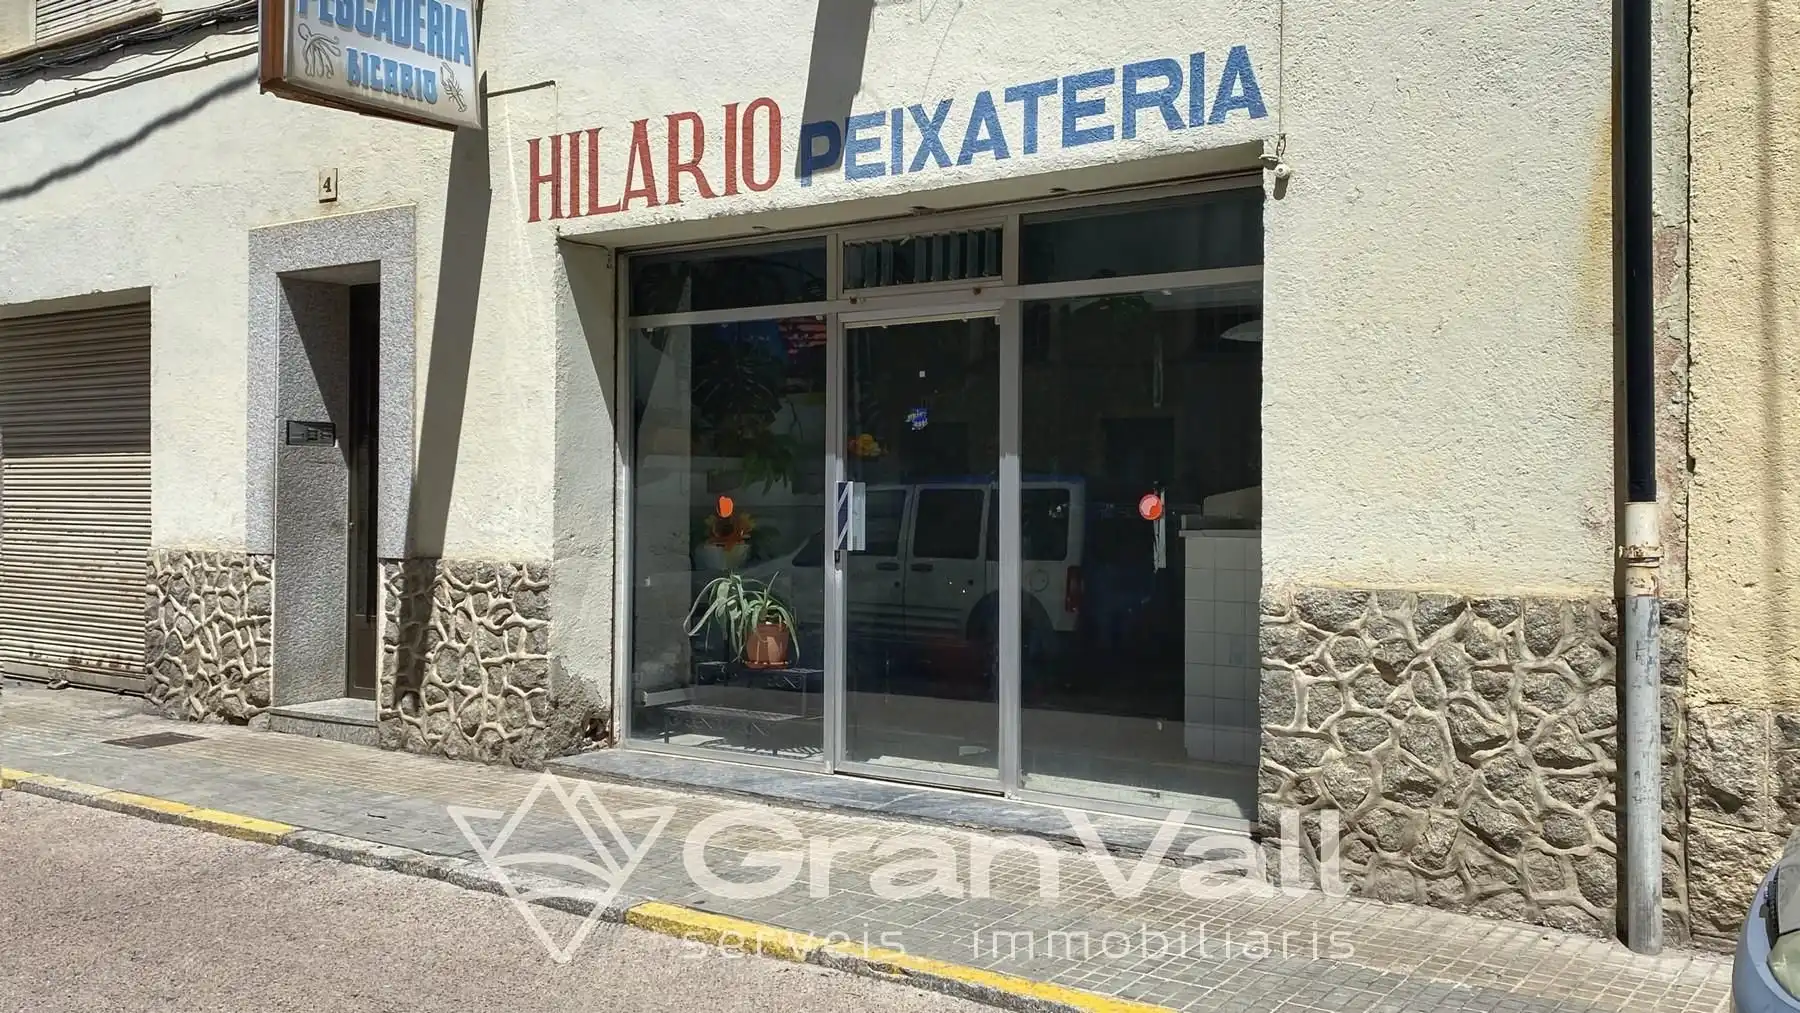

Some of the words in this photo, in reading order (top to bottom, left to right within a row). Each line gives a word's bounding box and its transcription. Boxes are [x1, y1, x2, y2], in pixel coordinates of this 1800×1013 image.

[527, 96, 782, 223] HILARIO
[800, 45, 1268, 187] PEIXATERIA
[322, 176, 332, 193] 4
